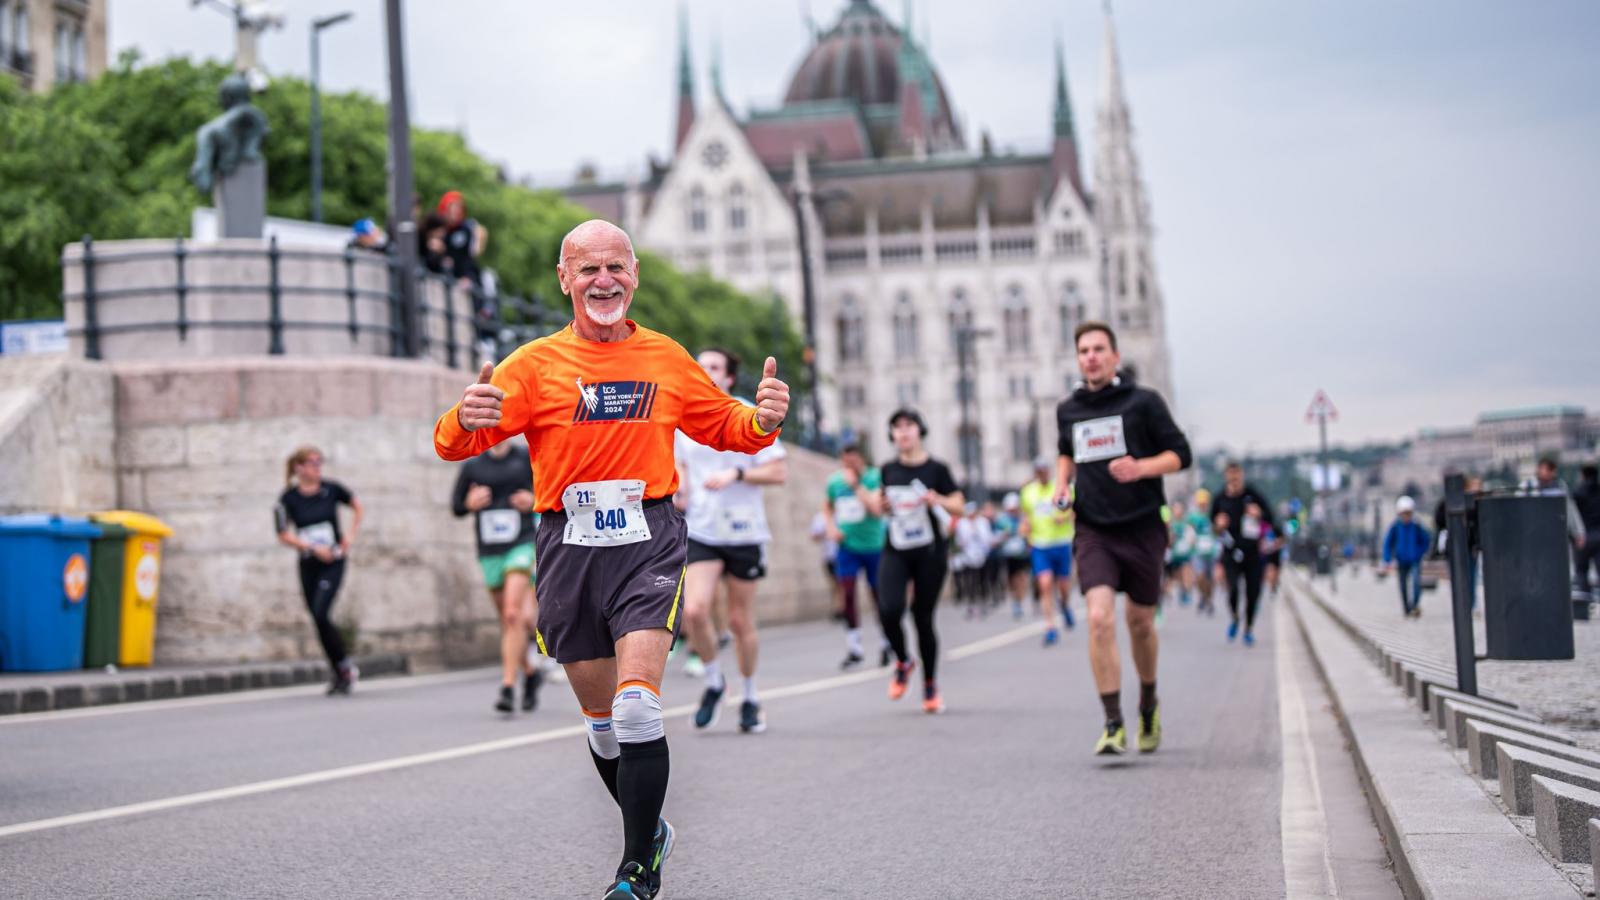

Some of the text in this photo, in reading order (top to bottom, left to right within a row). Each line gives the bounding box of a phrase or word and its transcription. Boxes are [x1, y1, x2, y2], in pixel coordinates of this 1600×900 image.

[602, 386, 616, 394] tcs
[576, 490, 590, 504] 21
[594, 508, 626, 530] 840
